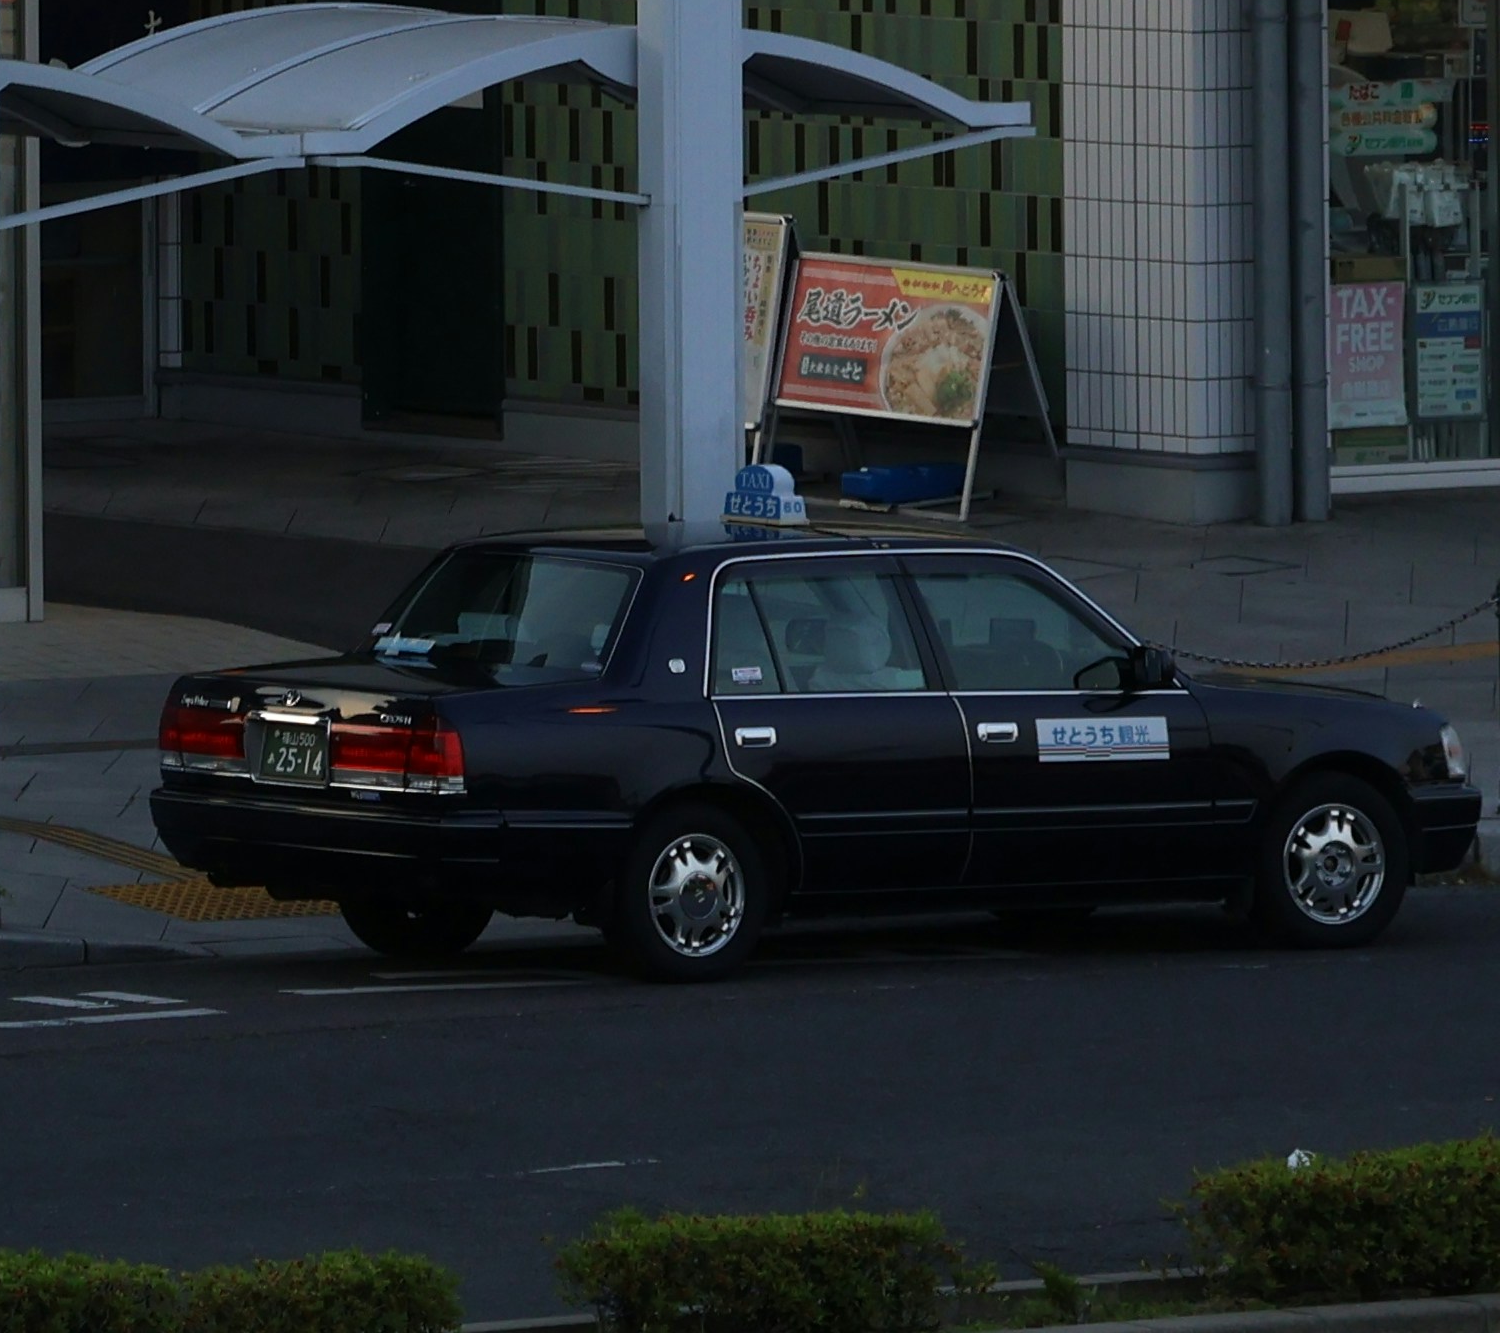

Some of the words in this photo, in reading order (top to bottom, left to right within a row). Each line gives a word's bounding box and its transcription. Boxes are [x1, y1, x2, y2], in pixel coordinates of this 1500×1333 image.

[1349, 84, 1379, 100] たばこ
[796, 286, 920, 332] 尾道ラーメン
[1337, 287, 1396, 319] TAX-
[1336, 321, 1394, 354] FREE
[1348, 356, 1385, 373] SHOP
[740, 472, 769, 489] TAXI
[731, 494, 777, 517] せとうち
[1052, 725, 1149, 745] せとうち観光
[275, 747, 322, 776] 25-14
